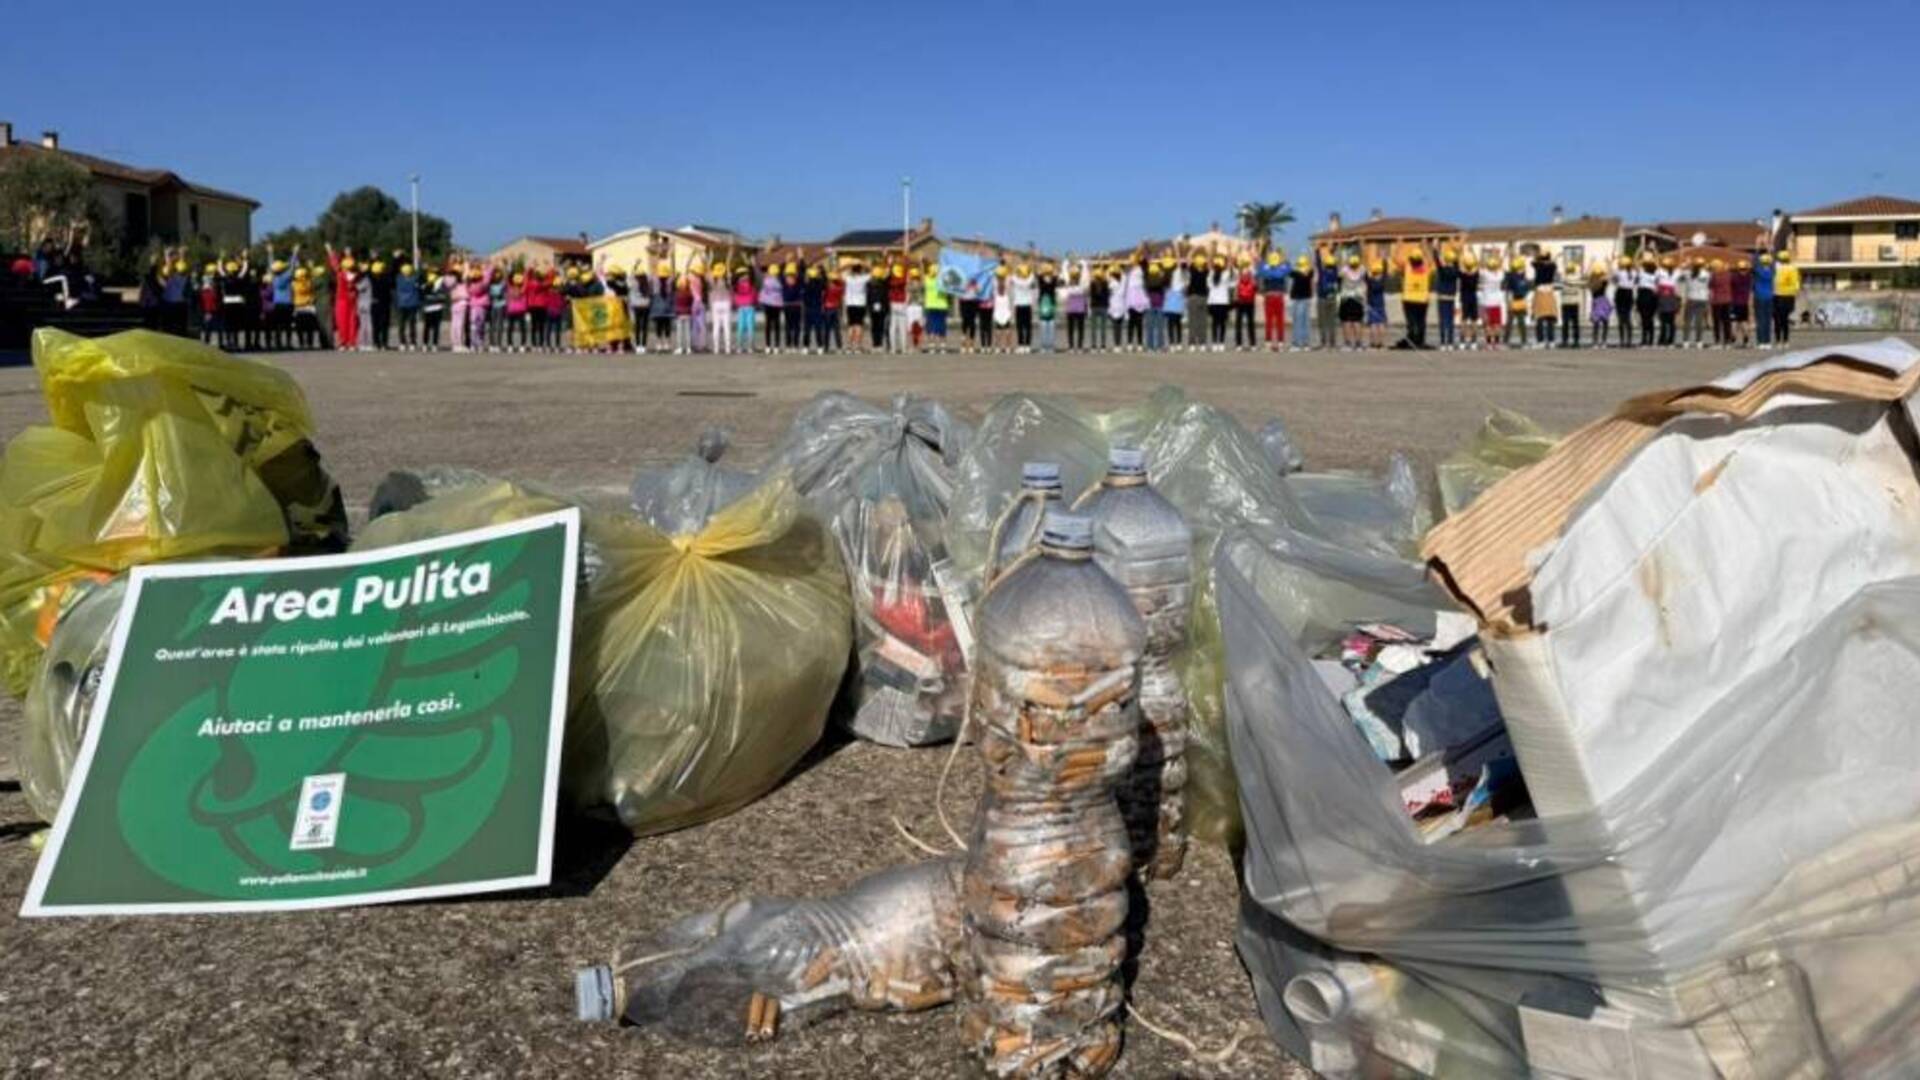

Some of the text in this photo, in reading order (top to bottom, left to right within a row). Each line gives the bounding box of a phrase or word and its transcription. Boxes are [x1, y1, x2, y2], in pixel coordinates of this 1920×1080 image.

[209, 560, 491, 625] Area Pulita
[291, 638, 339, 657] ripulita
[343, 635, 365, 649] dai
[368, 625, 424, 645] volontari
[427, 622, 441, 636] di
[198, 714, 273, 737] Aiutaci
[278, 718, 292, 732] a
[299, 700, 411, 731] mantenerla
